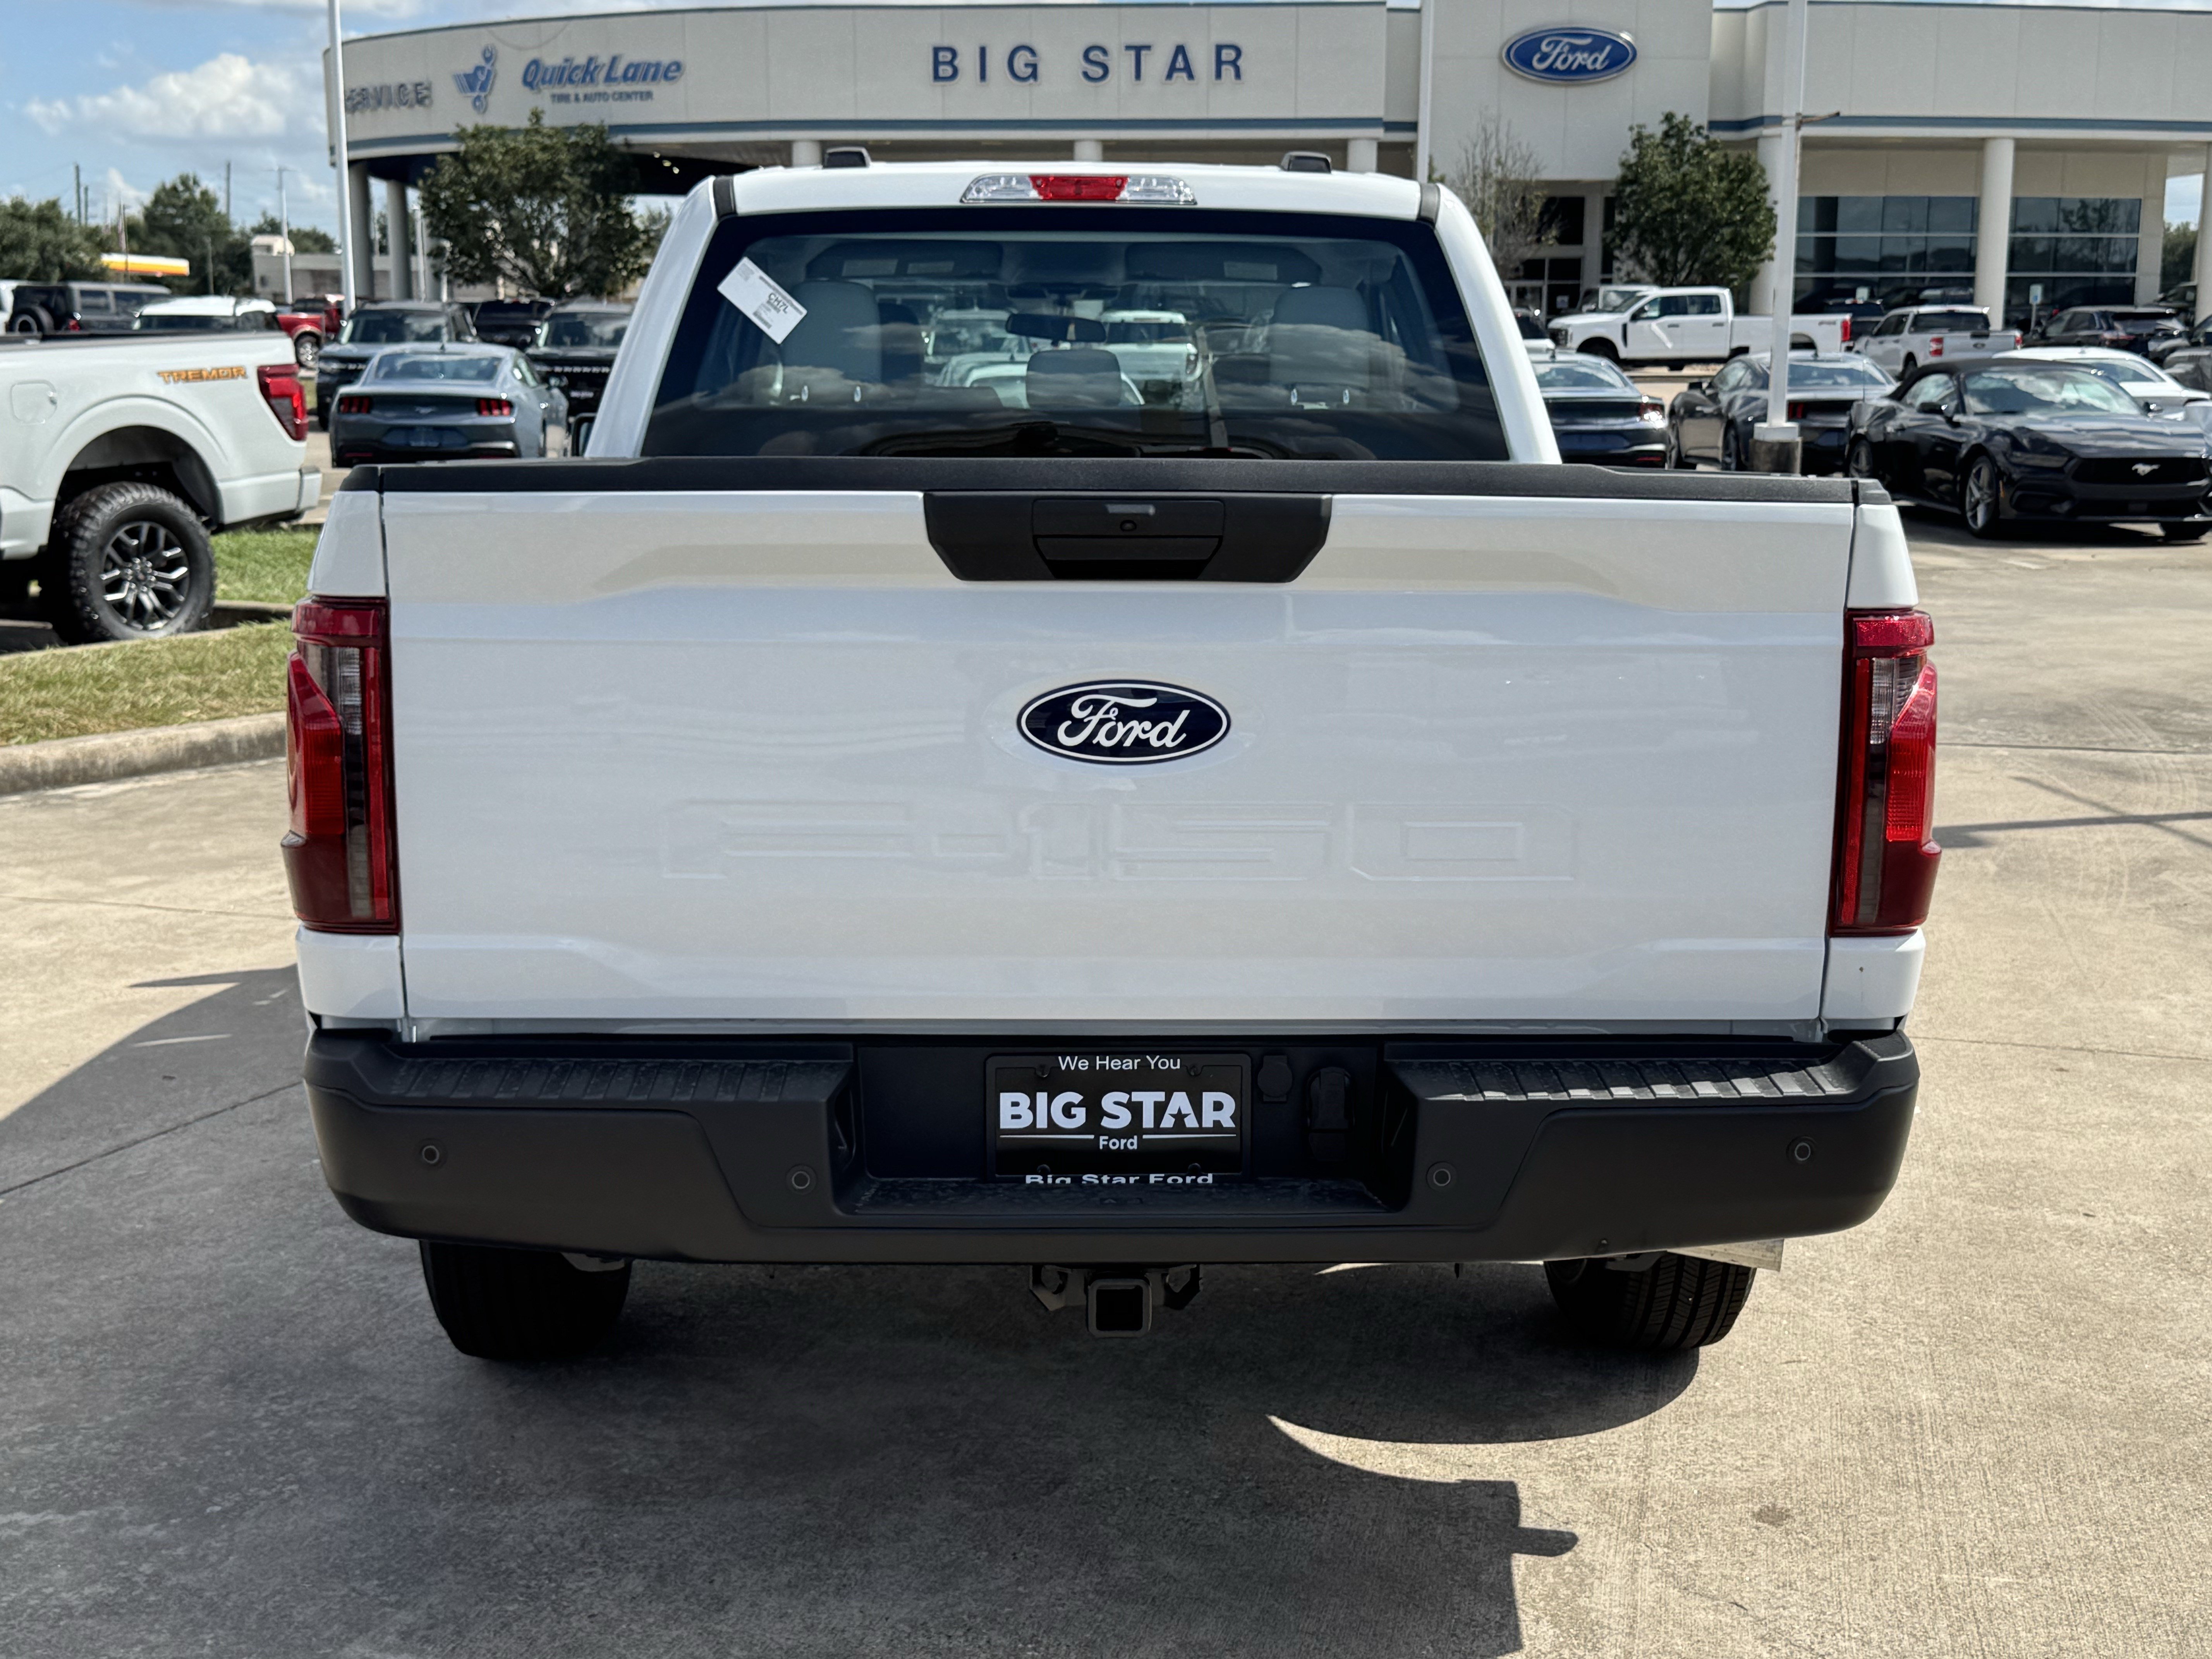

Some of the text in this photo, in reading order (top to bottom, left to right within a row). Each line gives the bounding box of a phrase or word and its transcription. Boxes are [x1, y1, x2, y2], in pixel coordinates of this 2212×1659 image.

[932, 44, 1243, 82] BIG STAR
[1532, 36, 1613, 70] Ford
[521, 55, 684, 91] Quick Lane
[345, 82, 433, 113] ERVICE
[550, 90, 654, 103] TIRE & AUTO CENTER
[156, 365, 248, 385] TREMOR
[1057, 694, 1190, 747] Ford
[1058, 1055, 1181, 1070] We Hear You
[1000, 1091, 1236, 1129] BIG STAR
[1099, 1135, 1138, 1150] Ford
[1082, 1174, 1140, 1184] Star
[1149, 1173, 1213, 1184] Ford
